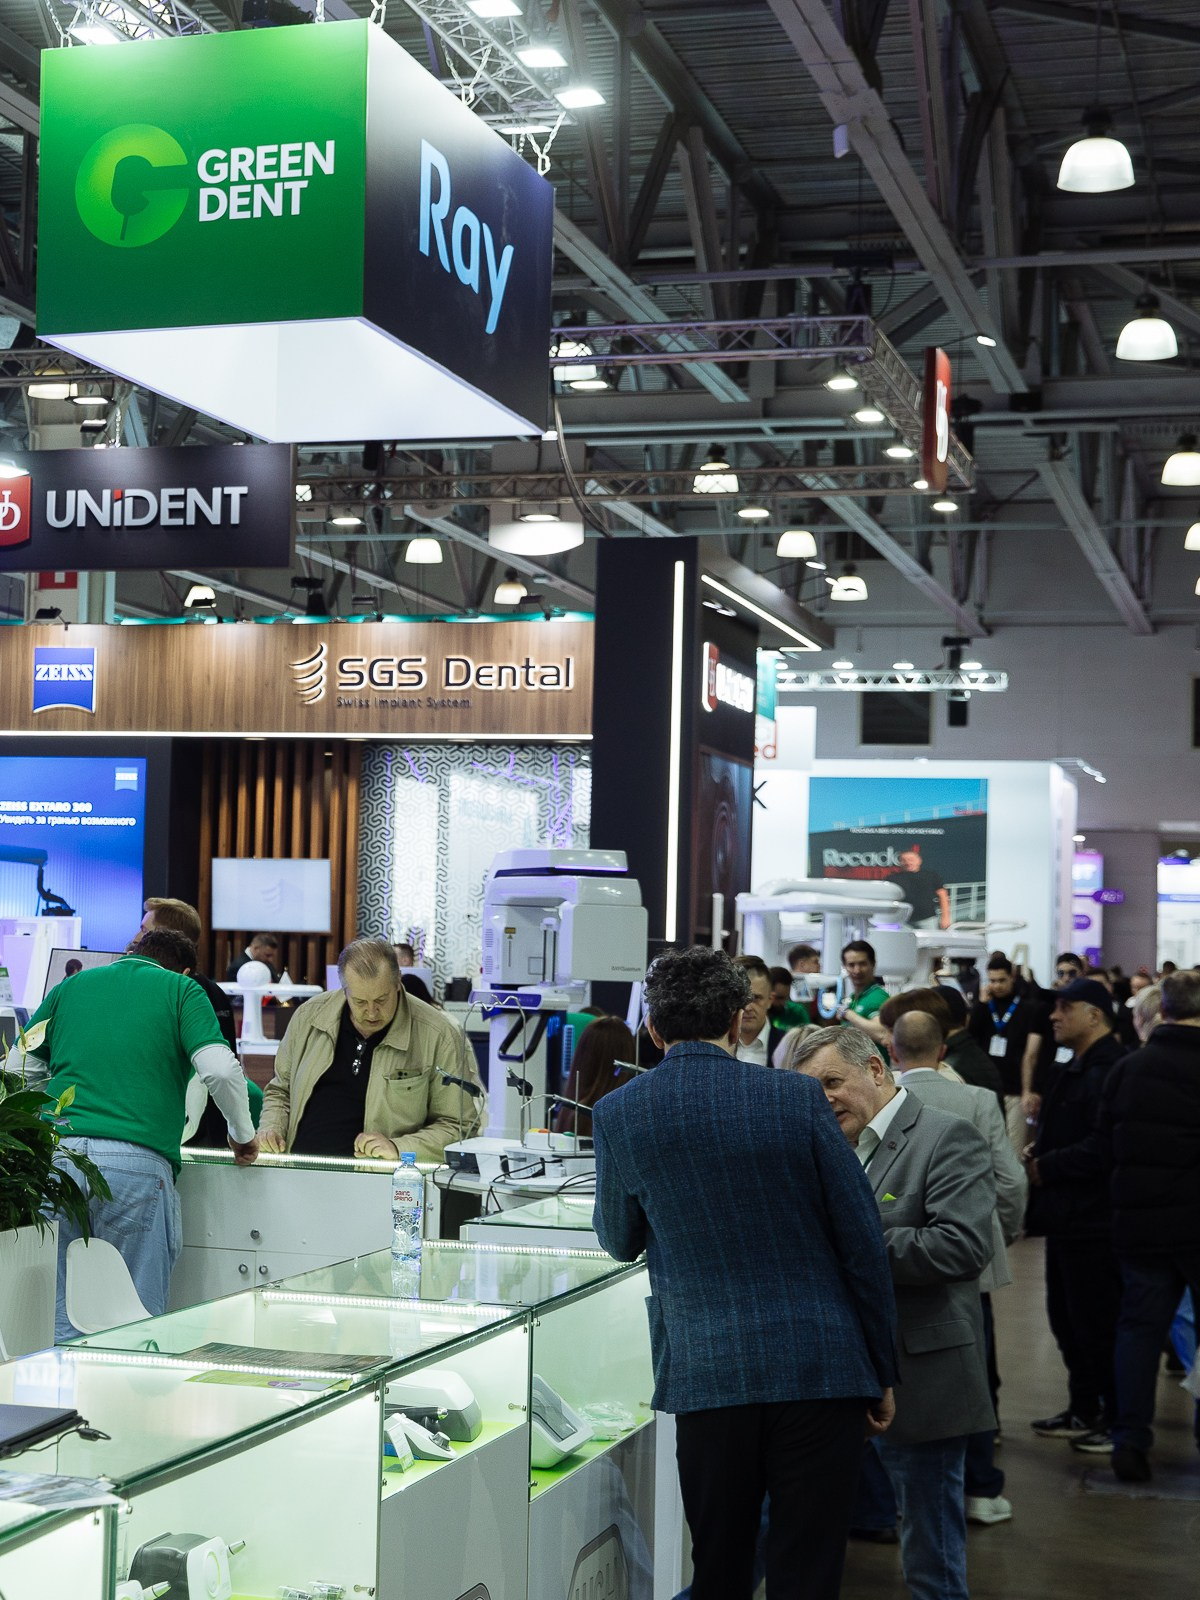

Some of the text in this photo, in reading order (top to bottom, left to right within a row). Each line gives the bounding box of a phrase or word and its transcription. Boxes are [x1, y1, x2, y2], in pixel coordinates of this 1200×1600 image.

[197, 140, 335, 184] GREEN
[199, 180, 308, 222] DENT
[419, 138, 514, 335] Ray
[35, 664, 93, 681] ZEISS
[338, 657, 571, 688] SGS Dental
[337, 696, 472, 710] Swiss Implant System
[0, 814, 137, 827] Увидеть за гранью возможного
